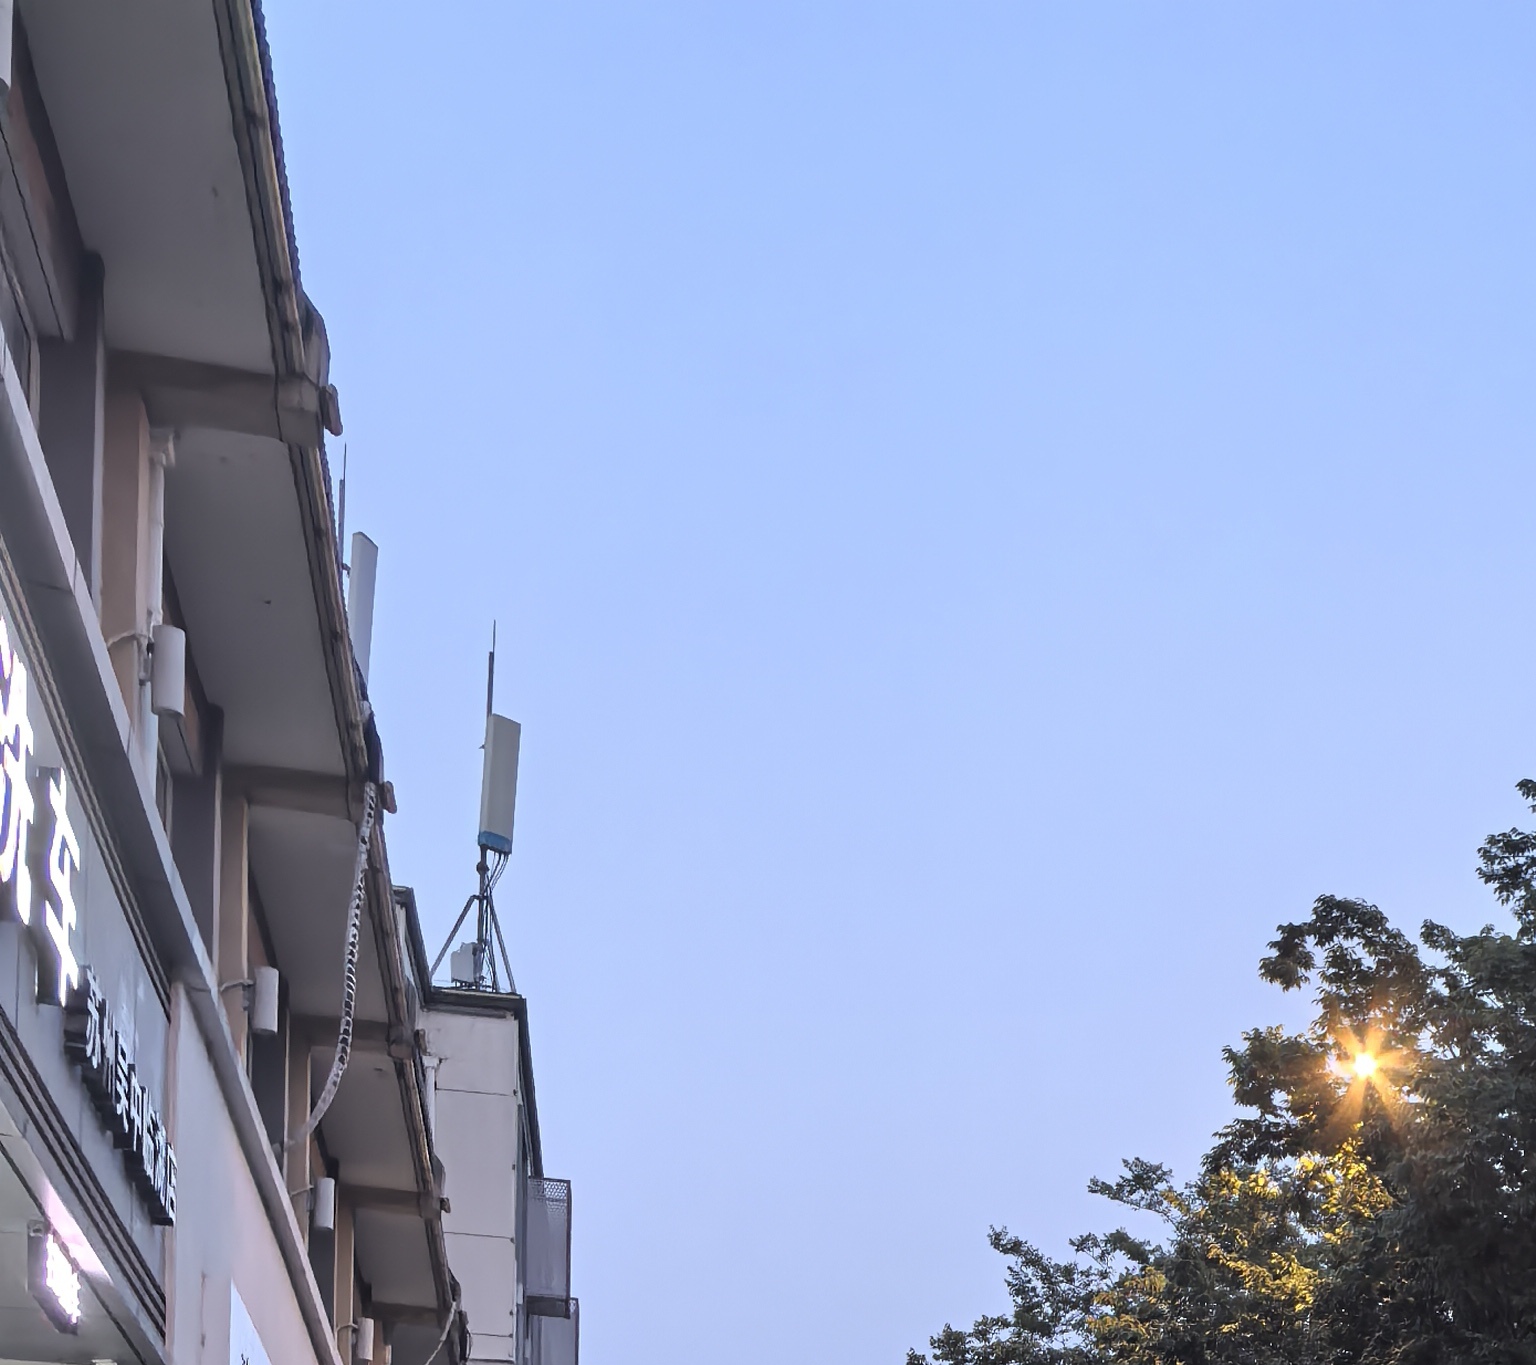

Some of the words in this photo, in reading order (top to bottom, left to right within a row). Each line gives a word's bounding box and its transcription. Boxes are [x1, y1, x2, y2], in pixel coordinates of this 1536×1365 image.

[86, 966, 178, 1226] 苏州吴中临湖店
